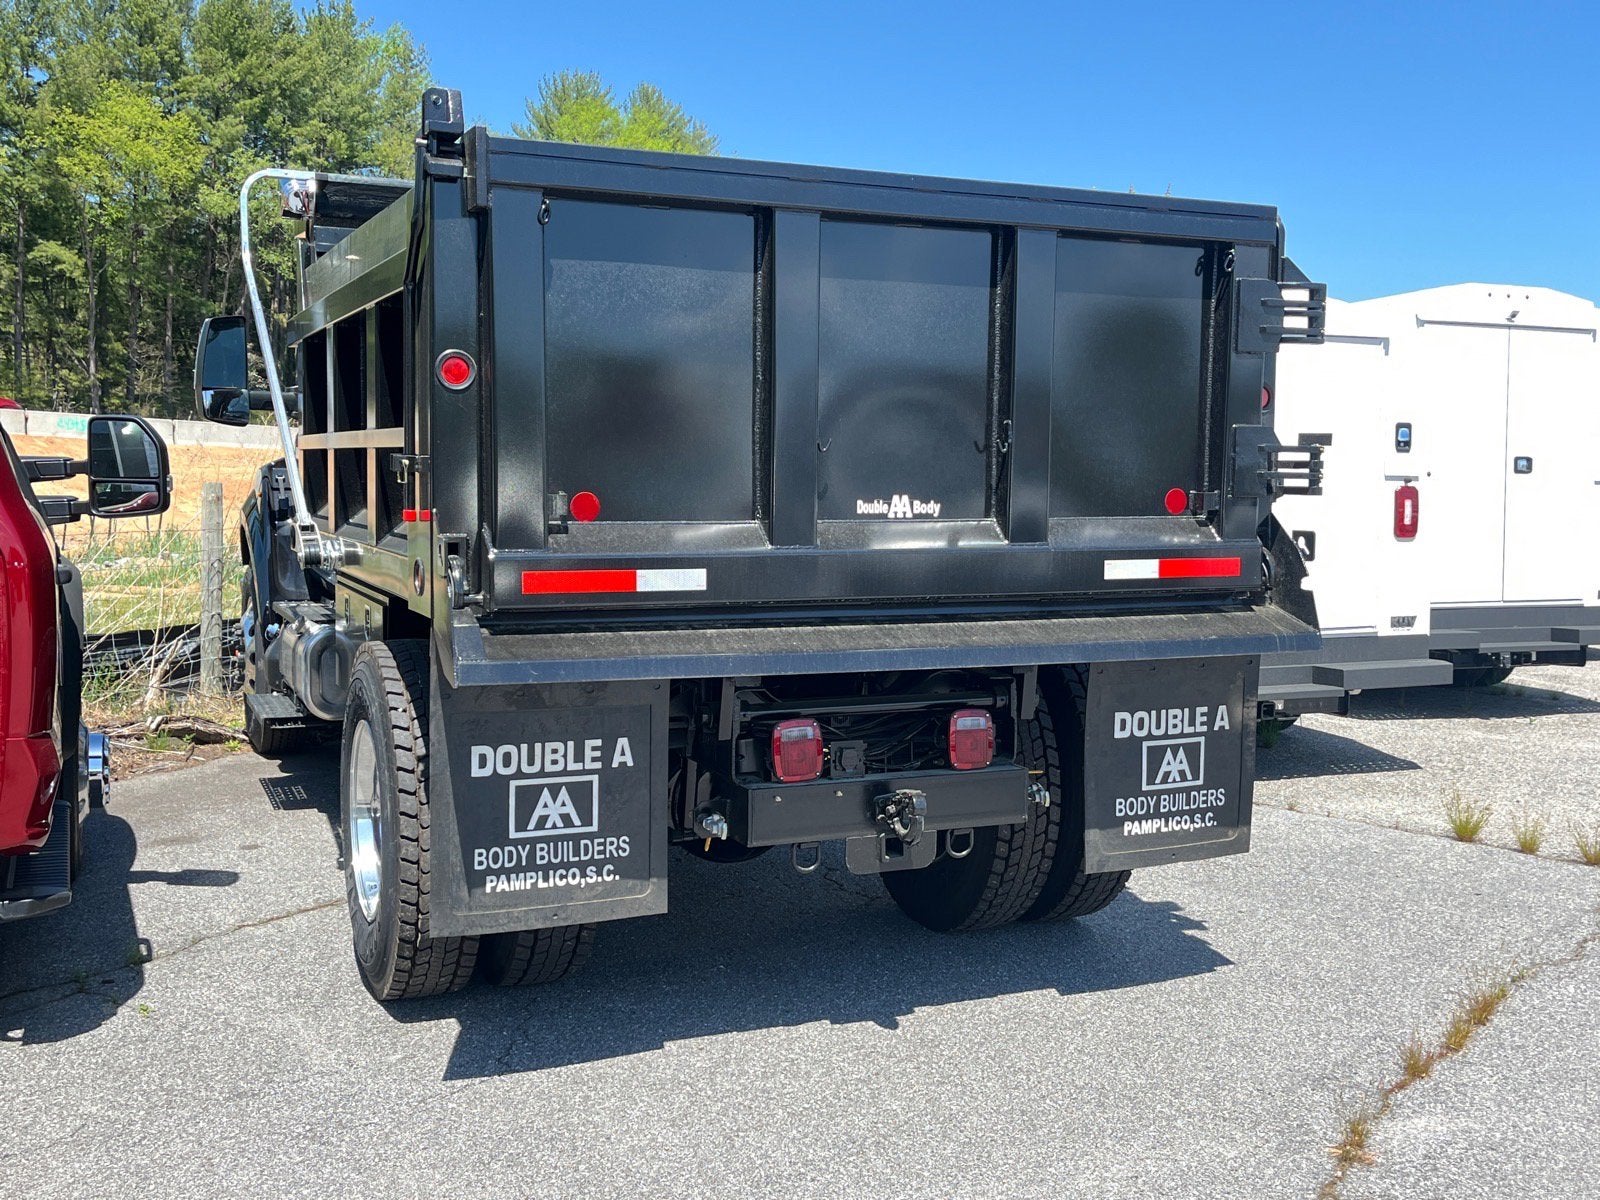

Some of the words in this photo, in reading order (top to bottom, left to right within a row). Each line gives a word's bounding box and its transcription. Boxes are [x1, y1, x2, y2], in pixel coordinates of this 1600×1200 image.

[857, 499, 888, 514] Double
[913, 499, 941, 517] Body
[1114, 706, 1208, 738] DOUBLE
[1213, 705, 1230, 731] A
[471, 739, 602, 778] DOUBLE
[611, 737, 634, 768] A
[1115, 795, 1157, 817] BODY
[1160, 788, 1226, 813] BUILDERS
[474, 843, 531, 871] BODY
[536, 836, 630, 865] BUILDERS
